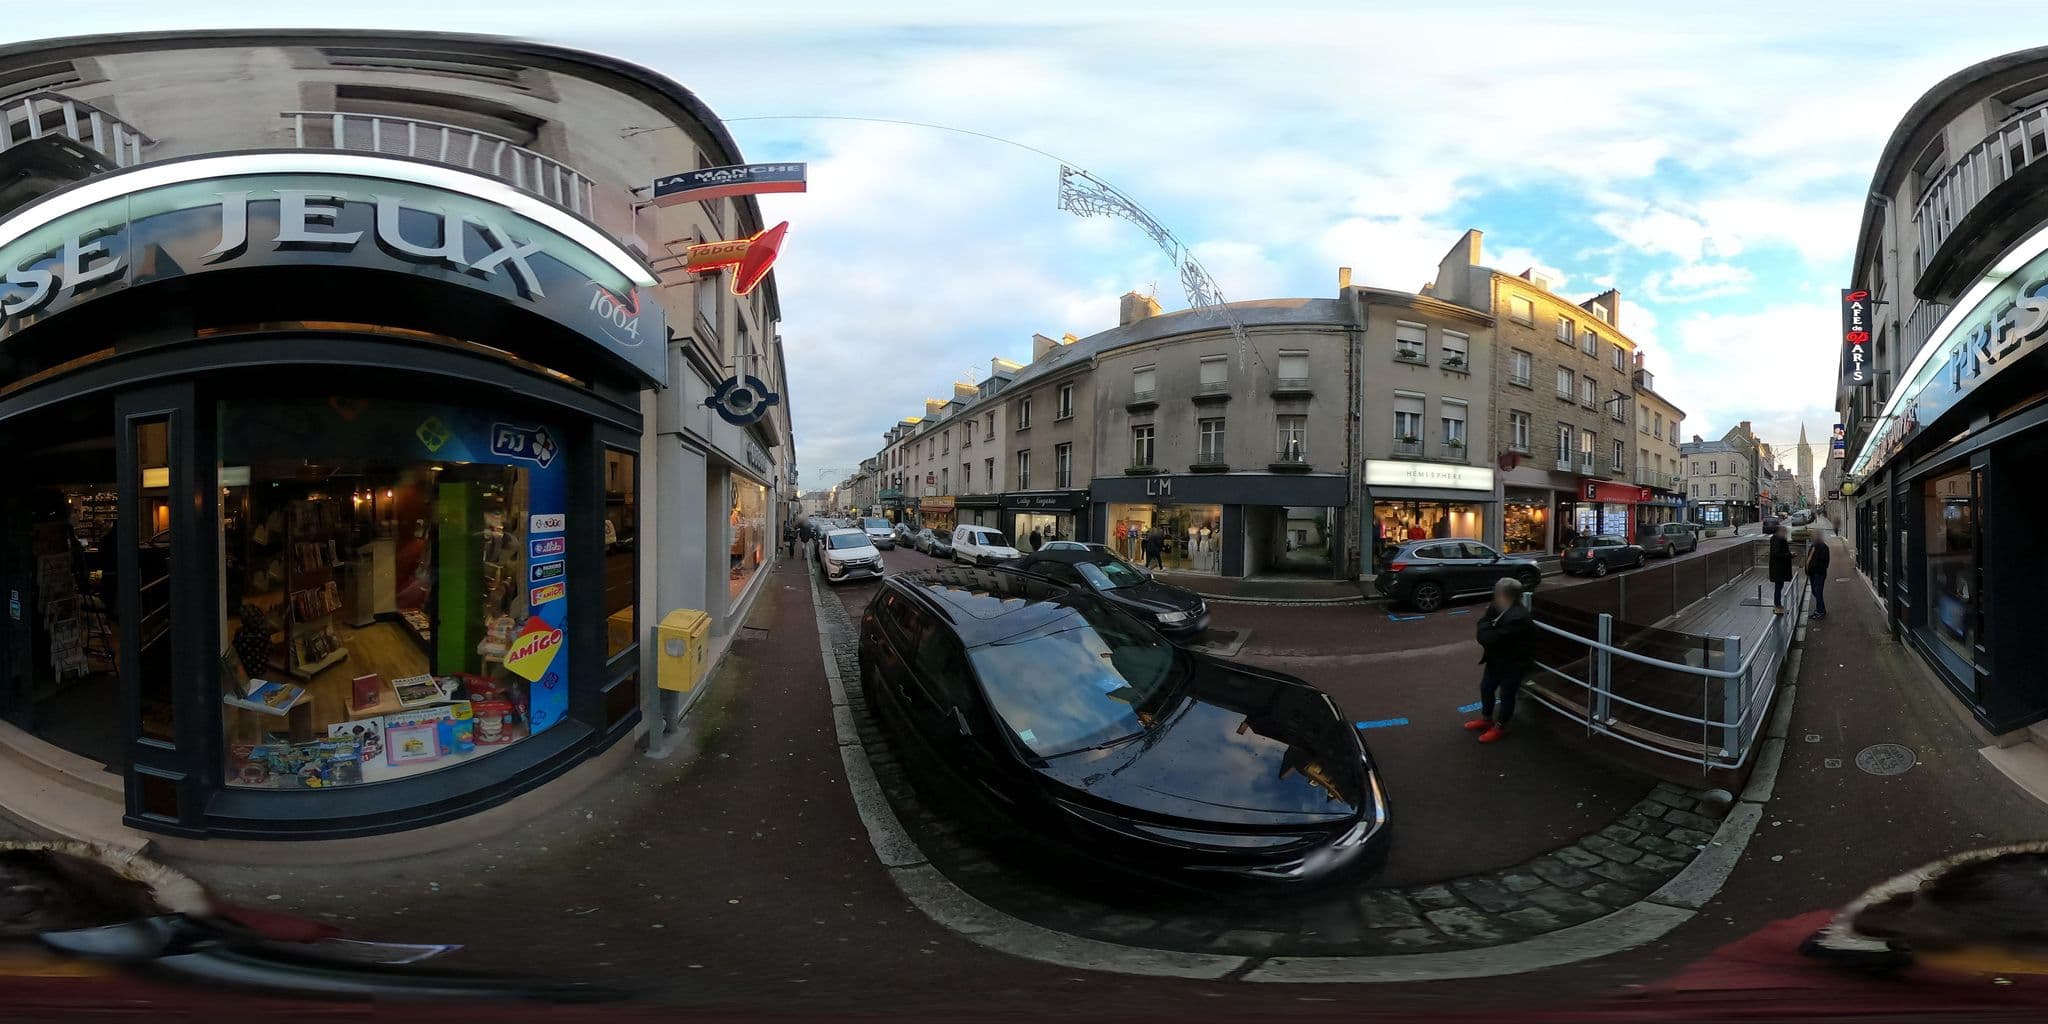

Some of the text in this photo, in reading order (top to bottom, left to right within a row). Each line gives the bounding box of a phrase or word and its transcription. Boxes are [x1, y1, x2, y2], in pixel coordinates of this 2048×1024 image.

[657, 165, 801, 187] LA MANCHE
[199, 189, 547, 298] JEUX
[692, 244, 745, 257] Tabac
[1846, 331, 1870, 381] PARIS
[496, 430, 525, 452] FDJ
[1145, 477, 1173, 497] L'M
